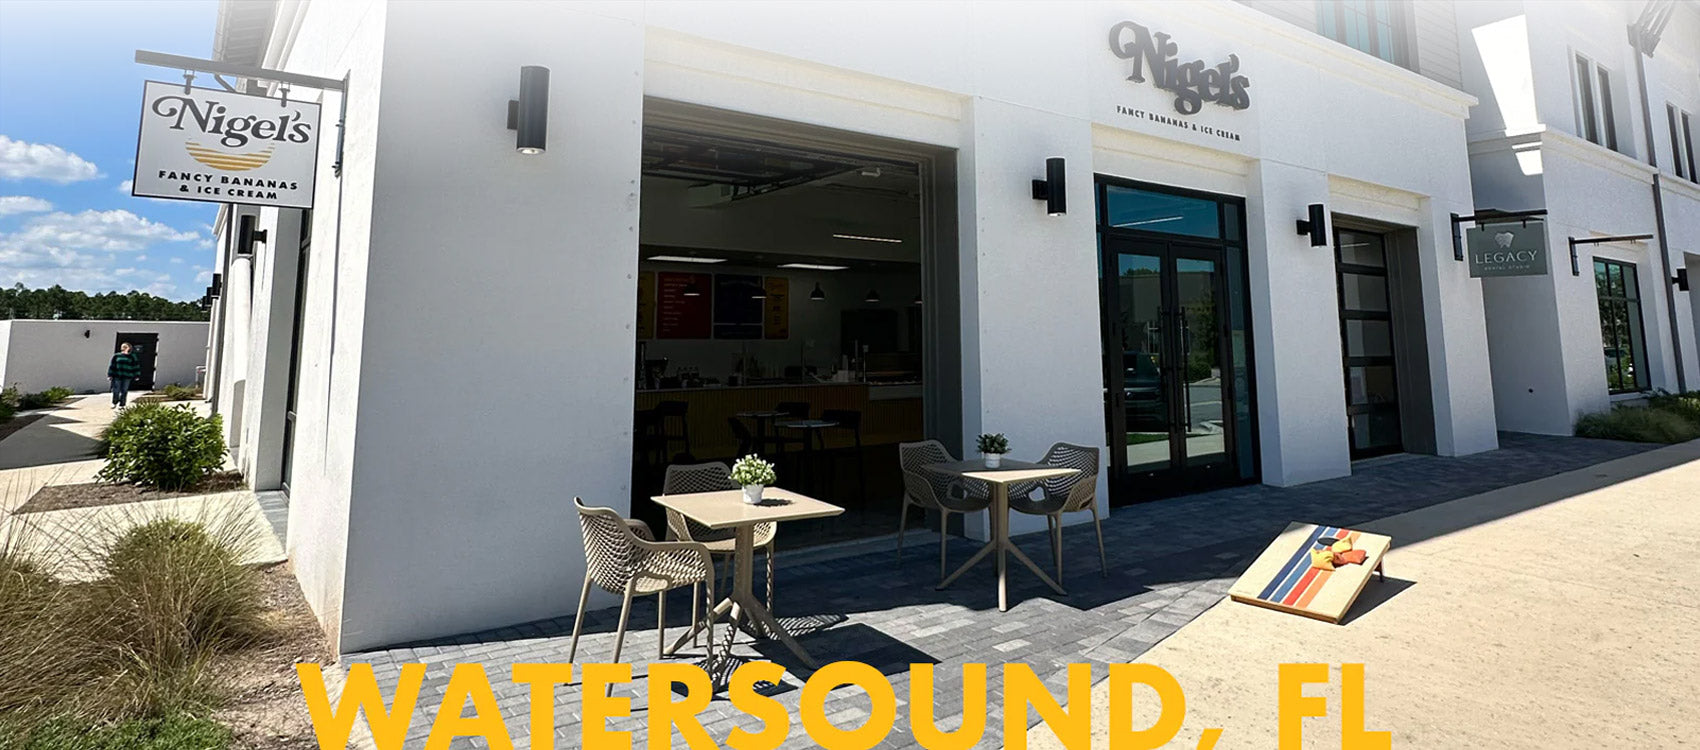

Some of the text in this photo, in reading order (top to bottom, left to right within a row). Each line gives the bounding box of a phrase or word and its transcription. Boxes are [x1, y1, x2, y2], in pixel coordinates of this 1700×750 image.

[1109, 20, 1250, 116] Nigel's
[152, 95, 312, 148] Nigel's
[1116, 105, 1241, 141] FANCY BANANAS & ICE CREAM
[158, 170, 298, 190] FANCY BANANAS
[179, 184, 278, 199] & ICE CREAM
[1475, 250, 1538, 264] LEGACY
